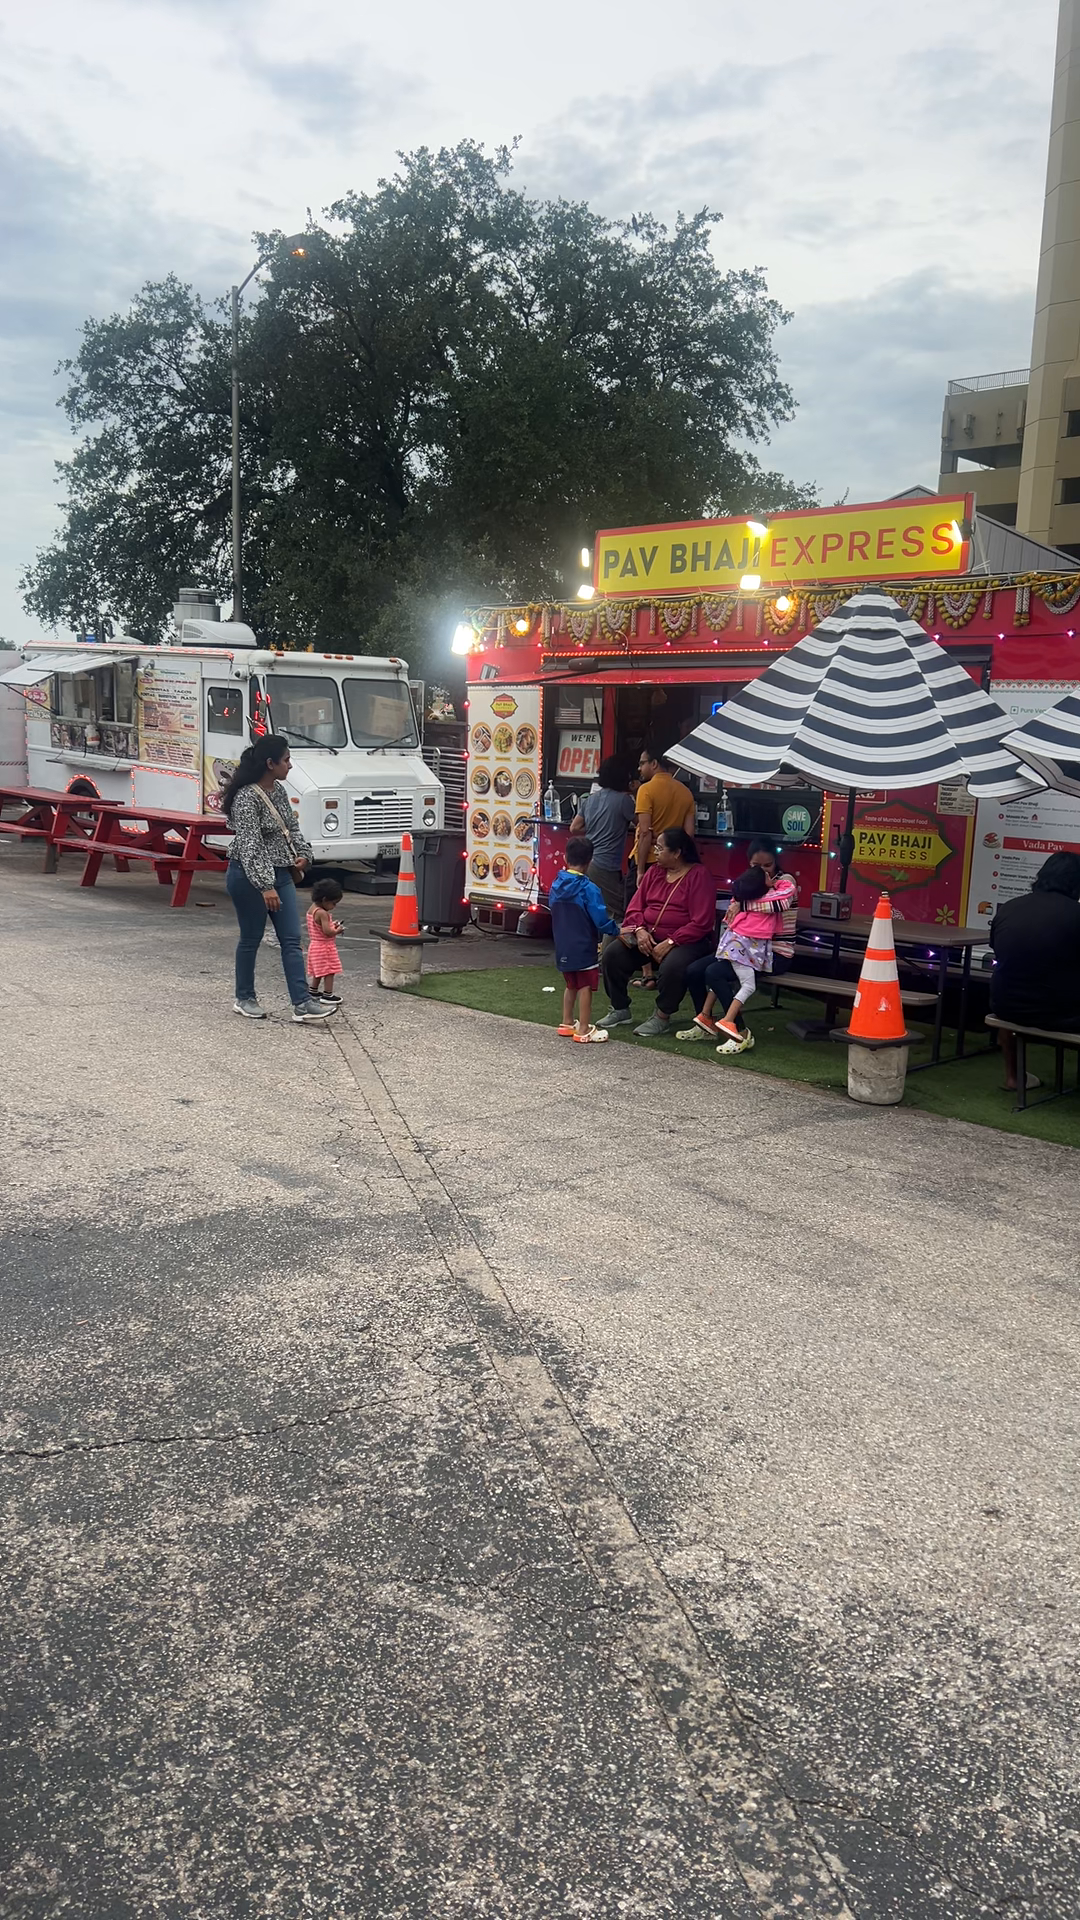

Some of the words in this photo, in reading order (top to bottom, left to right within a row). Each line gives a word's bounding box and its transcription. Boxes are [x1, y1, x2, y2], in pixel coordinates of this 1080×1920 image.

[603, 545, 658, 579] PAV
[670, 536, 761, 575] BHAJI
[770, 523, 955, 568] EXPRESS
[571, 734, 597, 743] WE'RE
[787, 811, 806, 821] SAVE
[787, 820, 805, 831] SOIL
[859, 831, 886, 845] PAV
[891, 833, 932, 849] BHAJI
[1022, 840, 1045, 850] Vada
[1047, 842, 1064, 851] Pav
[859, 846, 928, 861] EXPRESS
